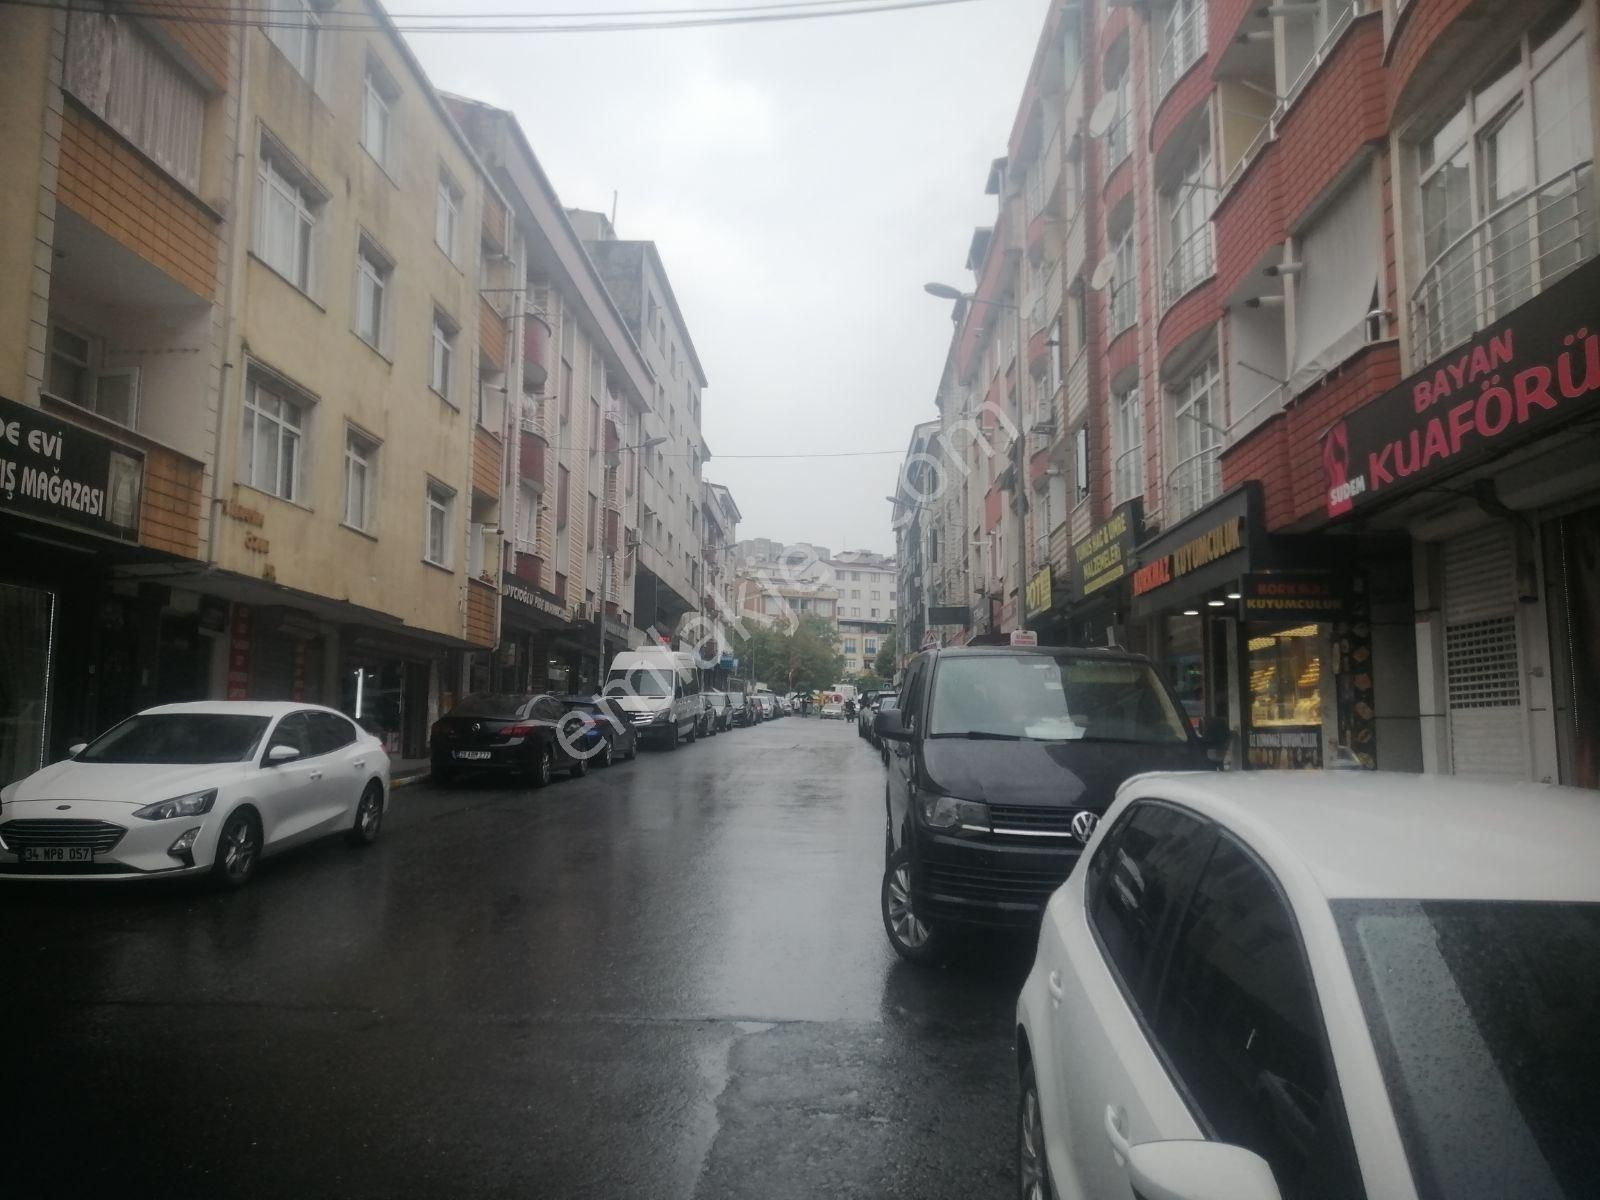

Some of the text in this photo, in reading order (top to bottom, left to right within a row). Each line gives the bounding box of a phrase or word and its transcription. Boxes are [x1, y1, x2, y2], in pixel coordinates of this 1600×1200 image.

[1413, 328, 1513, 414] BAYAN
[1369, 328, 1600, 491] KUAFÖRÜ
[28, 430, 63, 461] EVİ
[20, 465, 104, 517] MAĞAZASI
[1330, 475, 1366, 506] SUDEM
[1173, 516, 1241, 578] KUYUMCULUK
[1247, 599, 1341, 610] KUYUMCULUK
[26, 848, 39, 860] 34
